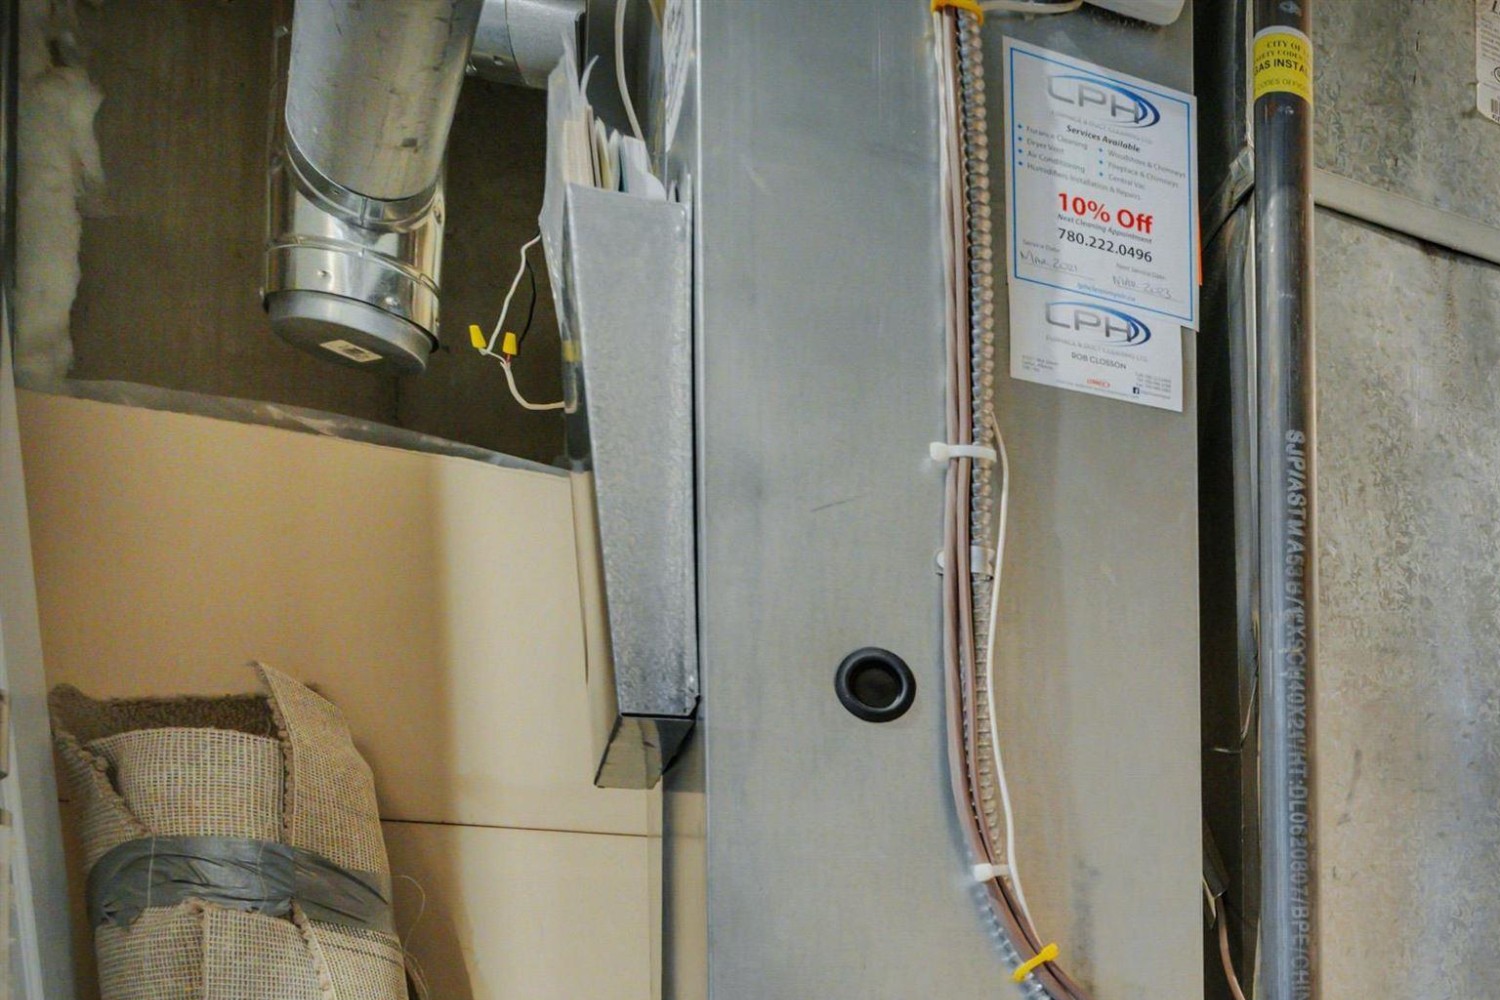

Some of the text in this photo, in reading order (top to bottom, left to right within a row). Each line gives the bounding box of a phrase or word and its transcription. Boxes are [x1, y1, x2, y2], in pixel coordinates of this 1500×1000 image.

[1048, 77, 1140, 124] LPH
[1066, 124, 1101, 141] Services
[1102, 136, 1140, 152] Available
[1038, 154, 1085, 174] Conditioning
[1057, 214, 1153, 244] Next Cleaning Appointment
[1058, 193, 1153, 234] 10% Off
[1057, 228, 1153, 263] 780.222.0496
[1046, 303, 1132, 342] LPH
